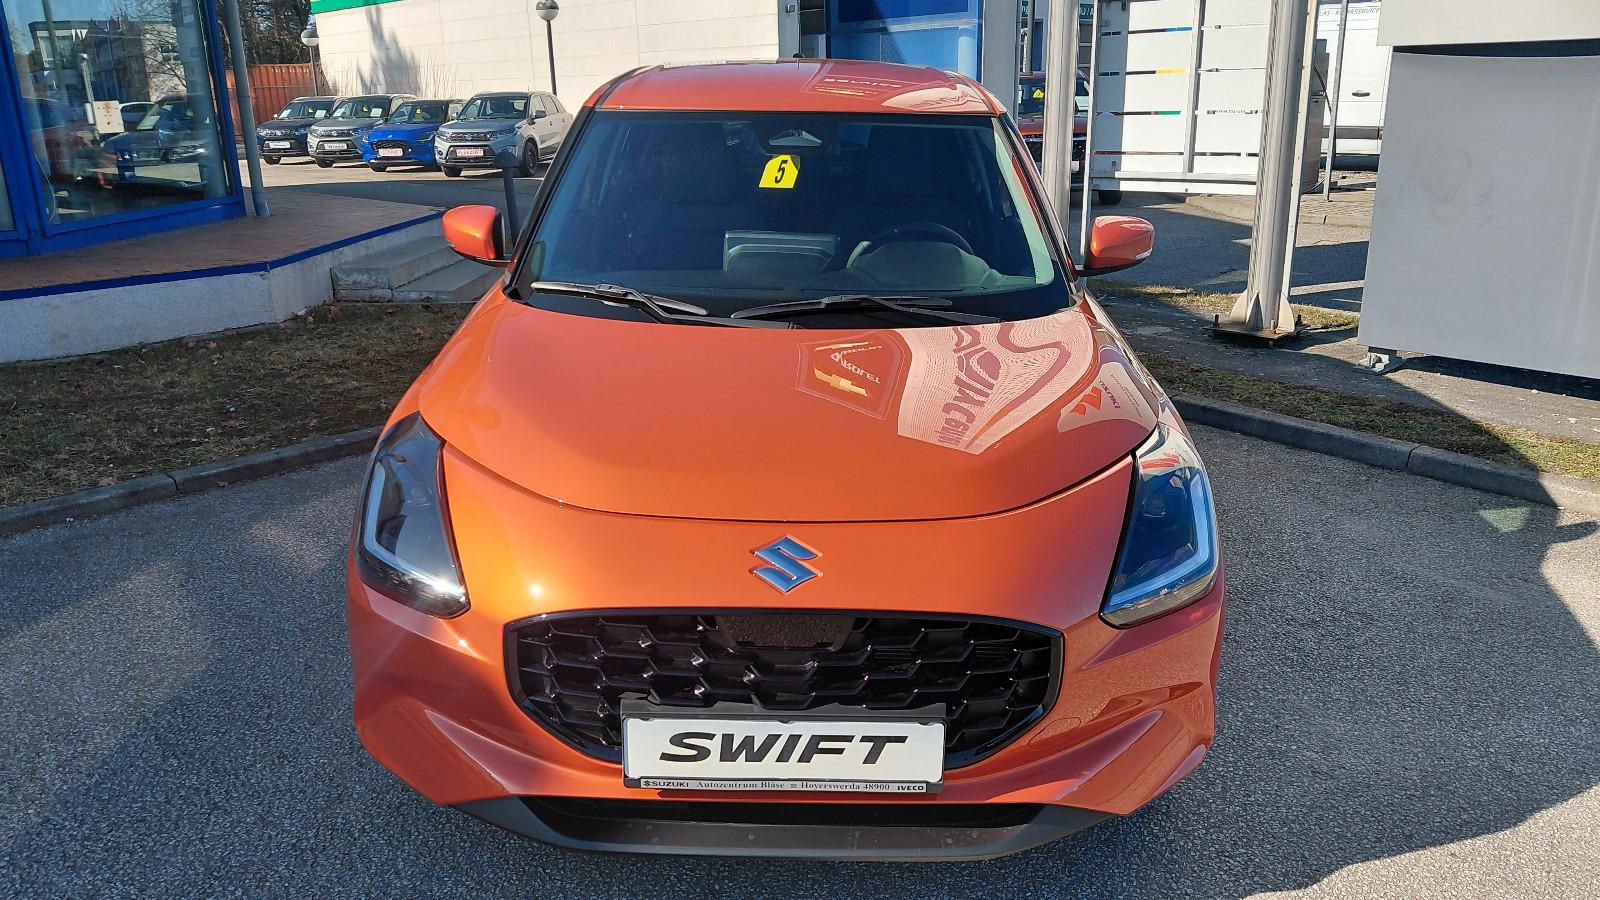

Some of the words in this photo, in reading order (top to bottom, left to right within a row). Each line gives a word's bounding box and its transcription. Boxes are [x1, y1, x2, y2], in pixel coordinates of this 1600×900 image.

[774, 159, 789, 184] 5
[659, 731, 909, 765] SWIFT
[651, 780, 690, 788] SUZUKI
[696, 781, 758, 789] Autozentrum
[801, 782, 861, 791] Hoyerswerda
